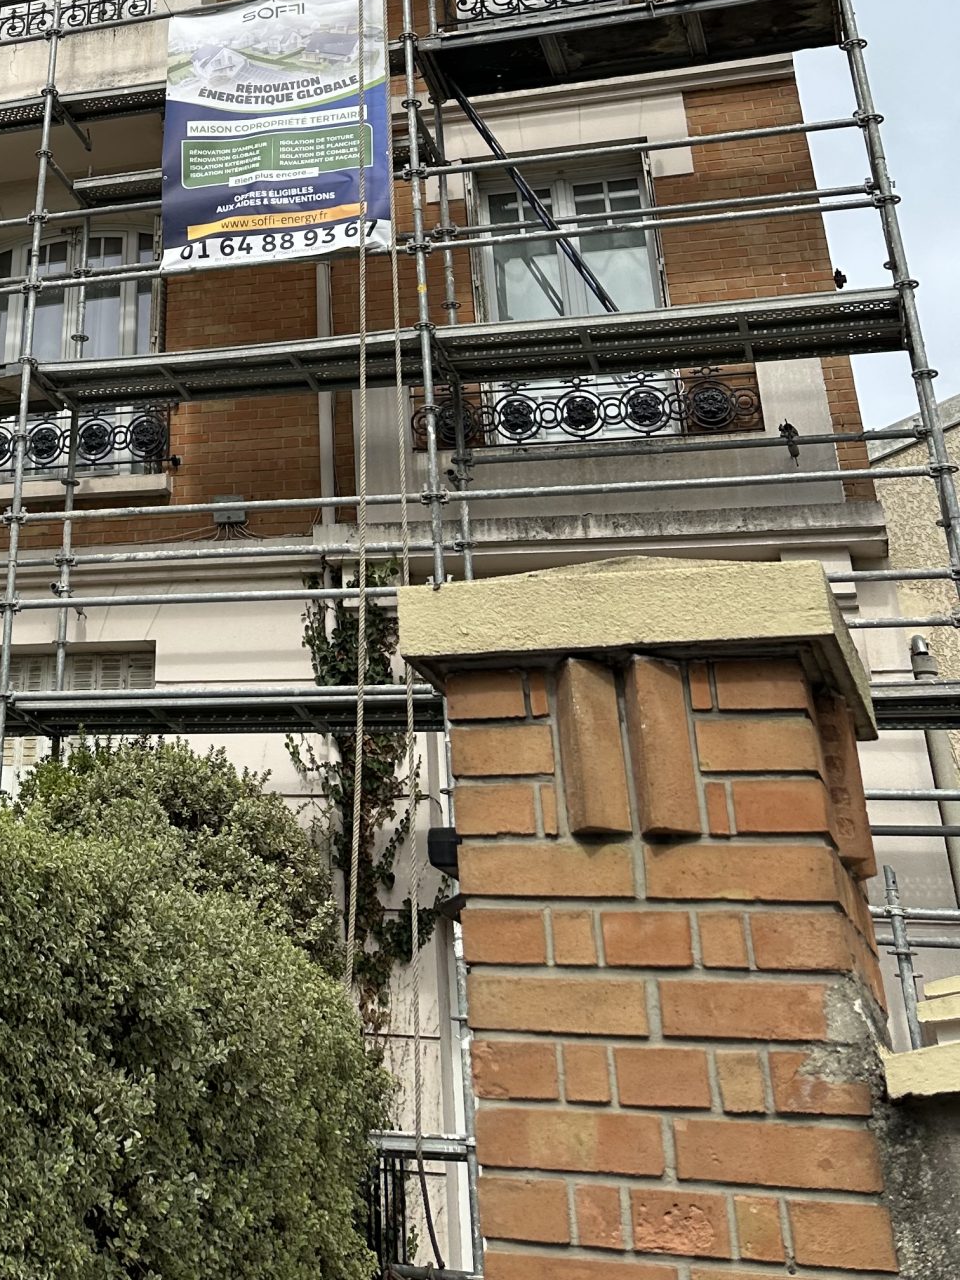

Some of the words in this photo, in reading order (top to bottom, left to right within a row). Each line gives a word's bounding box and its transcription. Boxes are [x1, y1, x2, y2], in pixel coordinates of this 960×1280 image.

[198, 87, 294, 106] ÉNERGÉTIQUE
[297, 74, 358, 100] GLOBALE
[236, 76, 320, 93] RÉNOVATION
[190, 126, 232, 134] MAISON
[234, 116, 308, 132] COPROPRIÉTÉ
[310, 110, 362, 122] TERTIAIR
[326, 134, 354, 142] TOITURE
[232, 142, 267, 153] D'AMPLEUR
[326, 147, 358, 155] COMBLES
[224, 156, 261, 168] EXTÉRIEURE
[232, 150, 260, 160] GLOBALE
[280, 158, 323, 166] RAVALEMENT
[190, 170, 223, 178] ISOLATION
[224, 162, 260, 174] INTÉRIEURE
[234, 176, 253, 184] Bien
[255, 172, 273, 180] plus
[234, 190, 267, 202] OFFRES
[268, 186, 314, 198] ÉLIGIBLES
[216, 204, 234, 214] AUX
[235, 198, 262, 209] AIDES
[270, 192, 336, 205] SUBVENTIONS
[180, 239, 210, 260] 01
[220, 236, 253, 256] 64
[261, 233, 294, 252] 88
[304, 226, 336, 247] 93
[344, 219, 378, 237] 67
